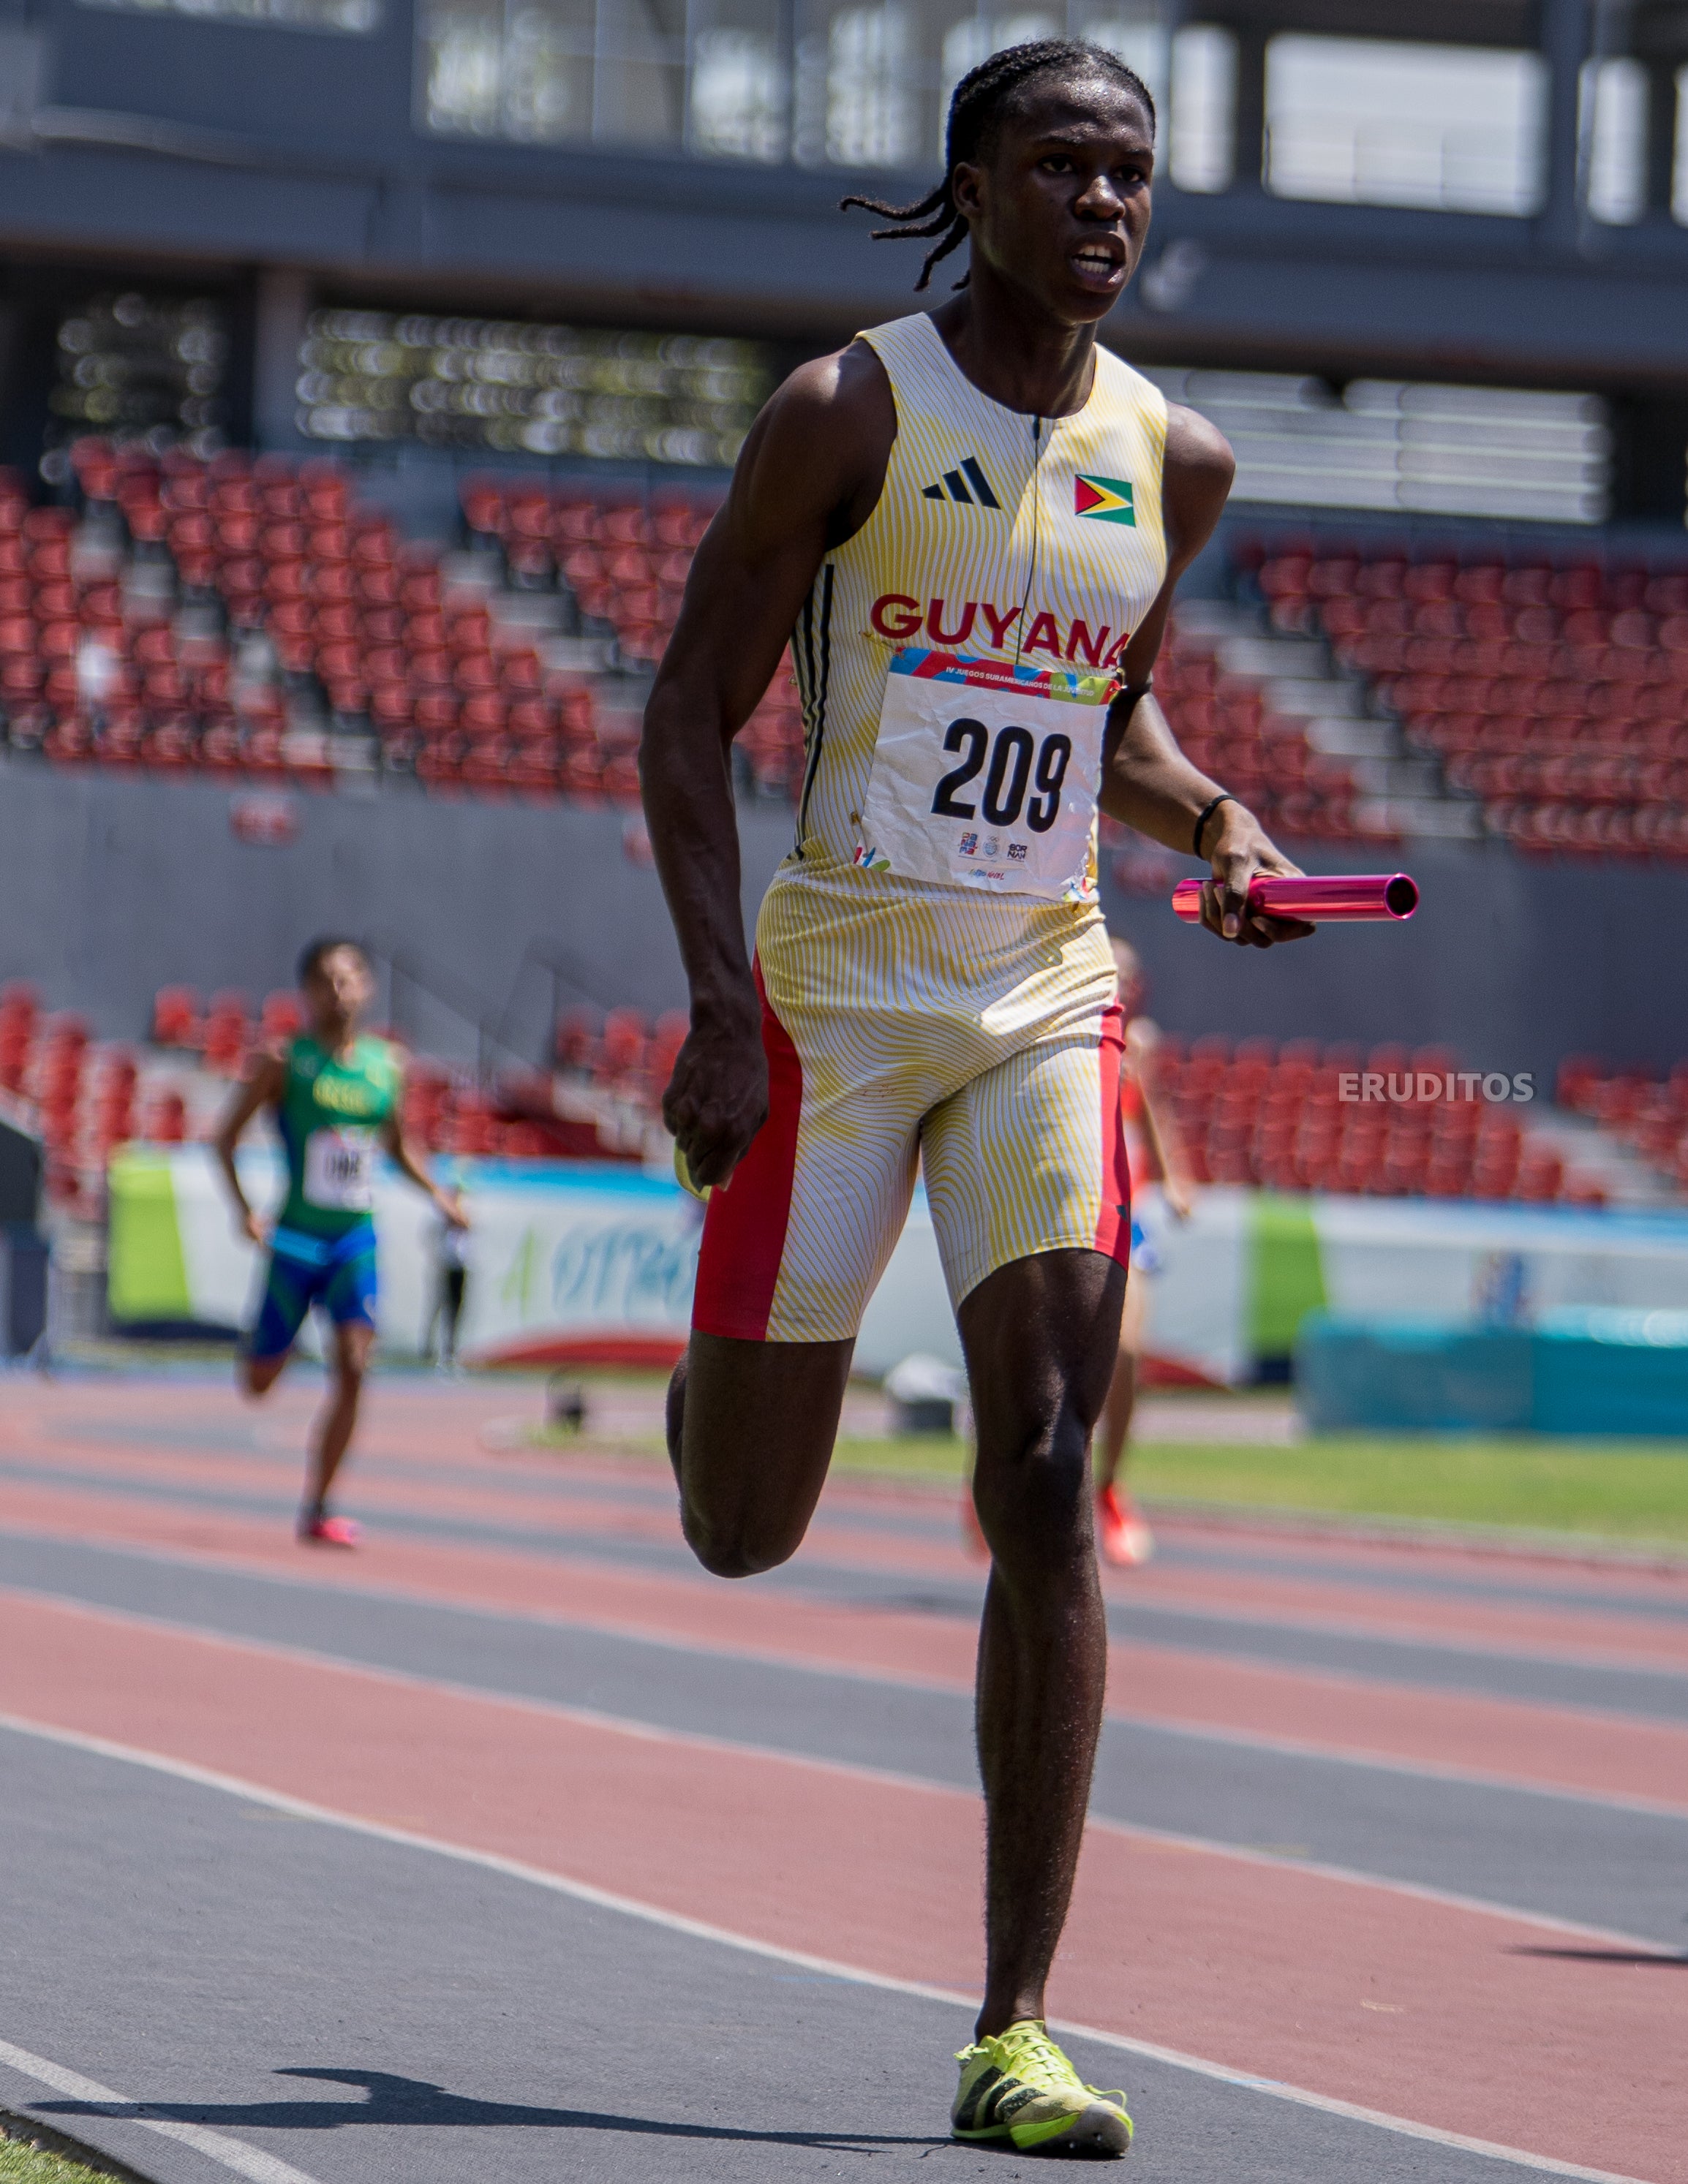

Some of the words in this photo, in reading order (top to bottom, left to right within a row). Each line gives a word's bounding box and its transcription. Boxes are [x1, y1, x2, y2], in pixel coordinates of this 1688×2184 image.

[870, 593, 1130, 670] GUYANA
[954, 668, 985, 679] JUEGOS
[930, 717, 1071, 834] 209
